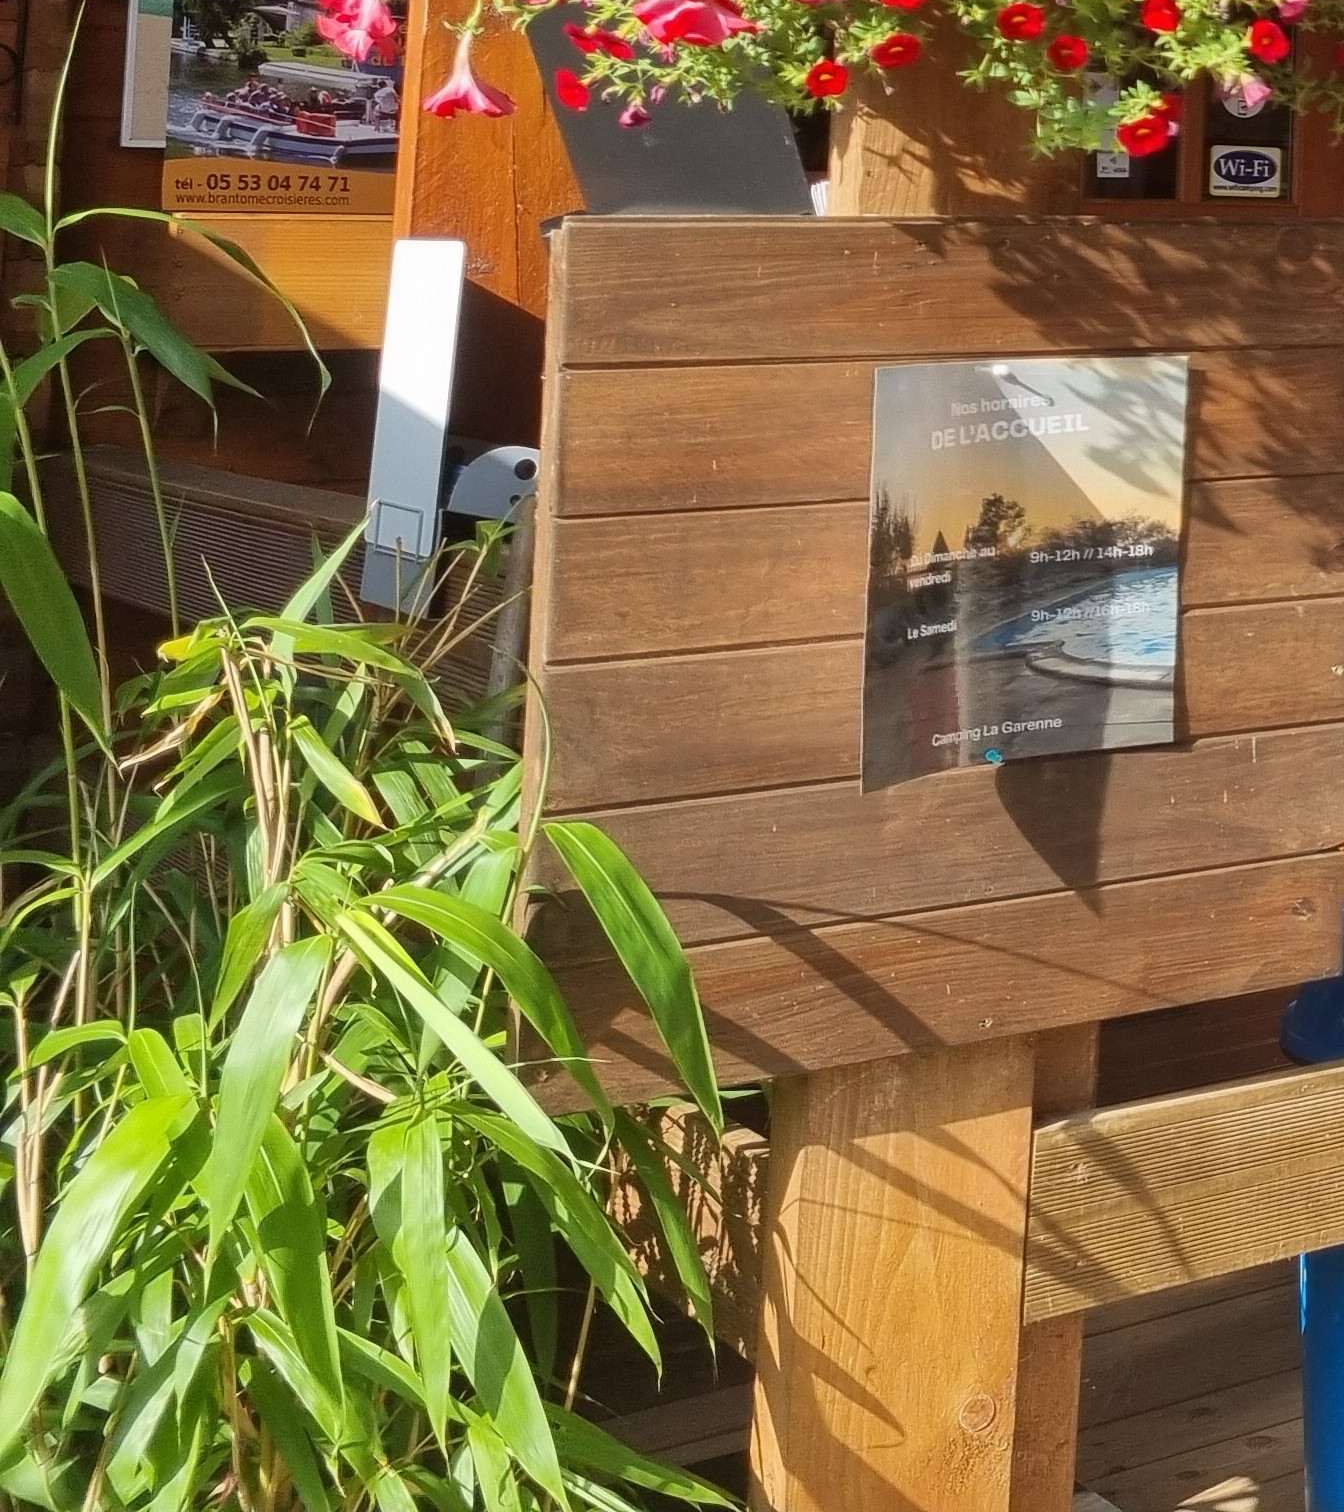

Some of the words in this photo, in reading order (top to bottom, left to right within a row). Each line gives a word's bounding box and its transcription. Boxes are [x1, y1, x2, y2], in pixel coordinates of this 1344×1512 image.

[1218, 158, 1270, 178] Wi-Fi
[174, 177, 193, 190] tél
[206, 173, 231, 191] 05
[237, 174, 261, 191] 53
[267, 175, 292, 192] 04
[298, 175, 321, 192] 74
[327, 176, 350, 193] 71
[175, 192, 350, 207] www.brantomecroisieres.com
[951, 401, 978, 417] Nos
[981, 395, 1049, 414] horaires
[930, 426, 956, 451] DE
[959, 412, 1090, 446] L'ACCUEIL
[924, 547, 977, 566] Dimanche
[979, 546, 996, 557] au
[1029, 549, 1081, 564] 9h-12h
[1096, 544, 1155, 560] 14h-18h
[907, 570, 952, 590] vendredi
[907, 627, 919, 640] Le
[919, 619, 958, 638] Samedi
[931, 728, 981, 747] Camping
[982, 724, 999, 737] La
[1001, 717, 1063, 734] Garenne
